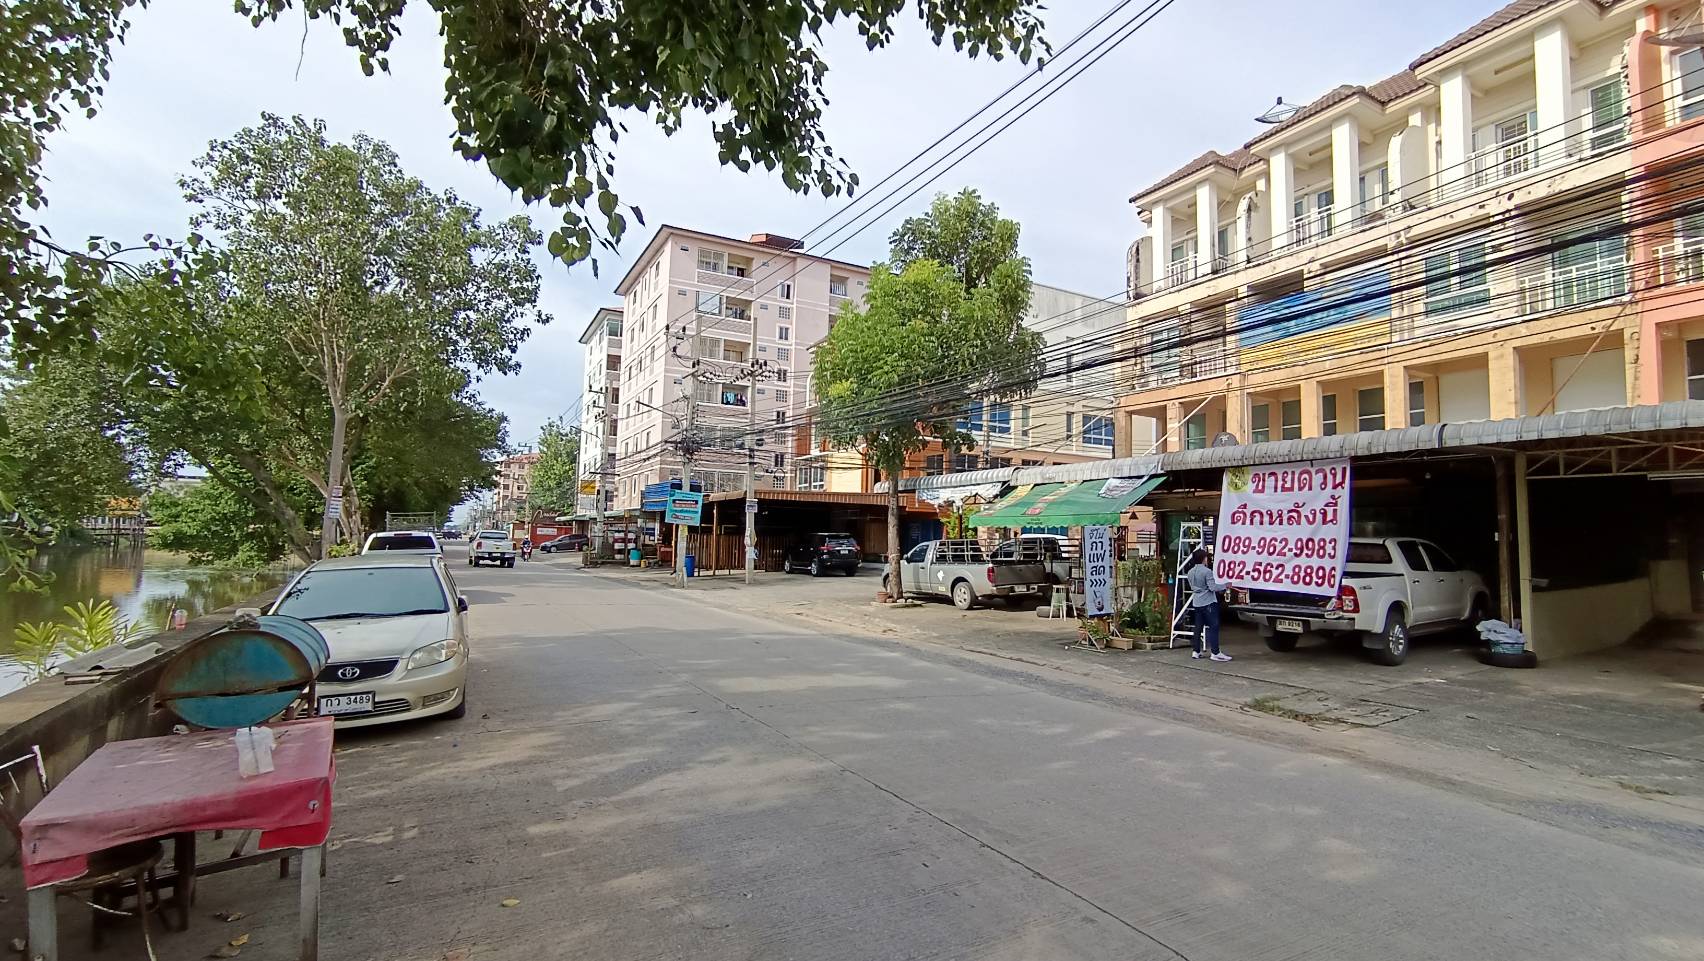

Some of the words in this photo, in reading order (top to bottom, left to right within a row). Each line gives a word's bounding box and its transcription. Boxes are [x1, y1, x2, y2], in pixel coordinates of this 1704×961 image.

[1230, 494, 1342, 526] ตึกหลังนี้
[1221, 534, 1337, 560] 089-962-9983
[1090, 564, 1106, 577] สด
[1216, 558, 1337, 589] 082-562-8896
[346, 695, 371, 705] 3489
